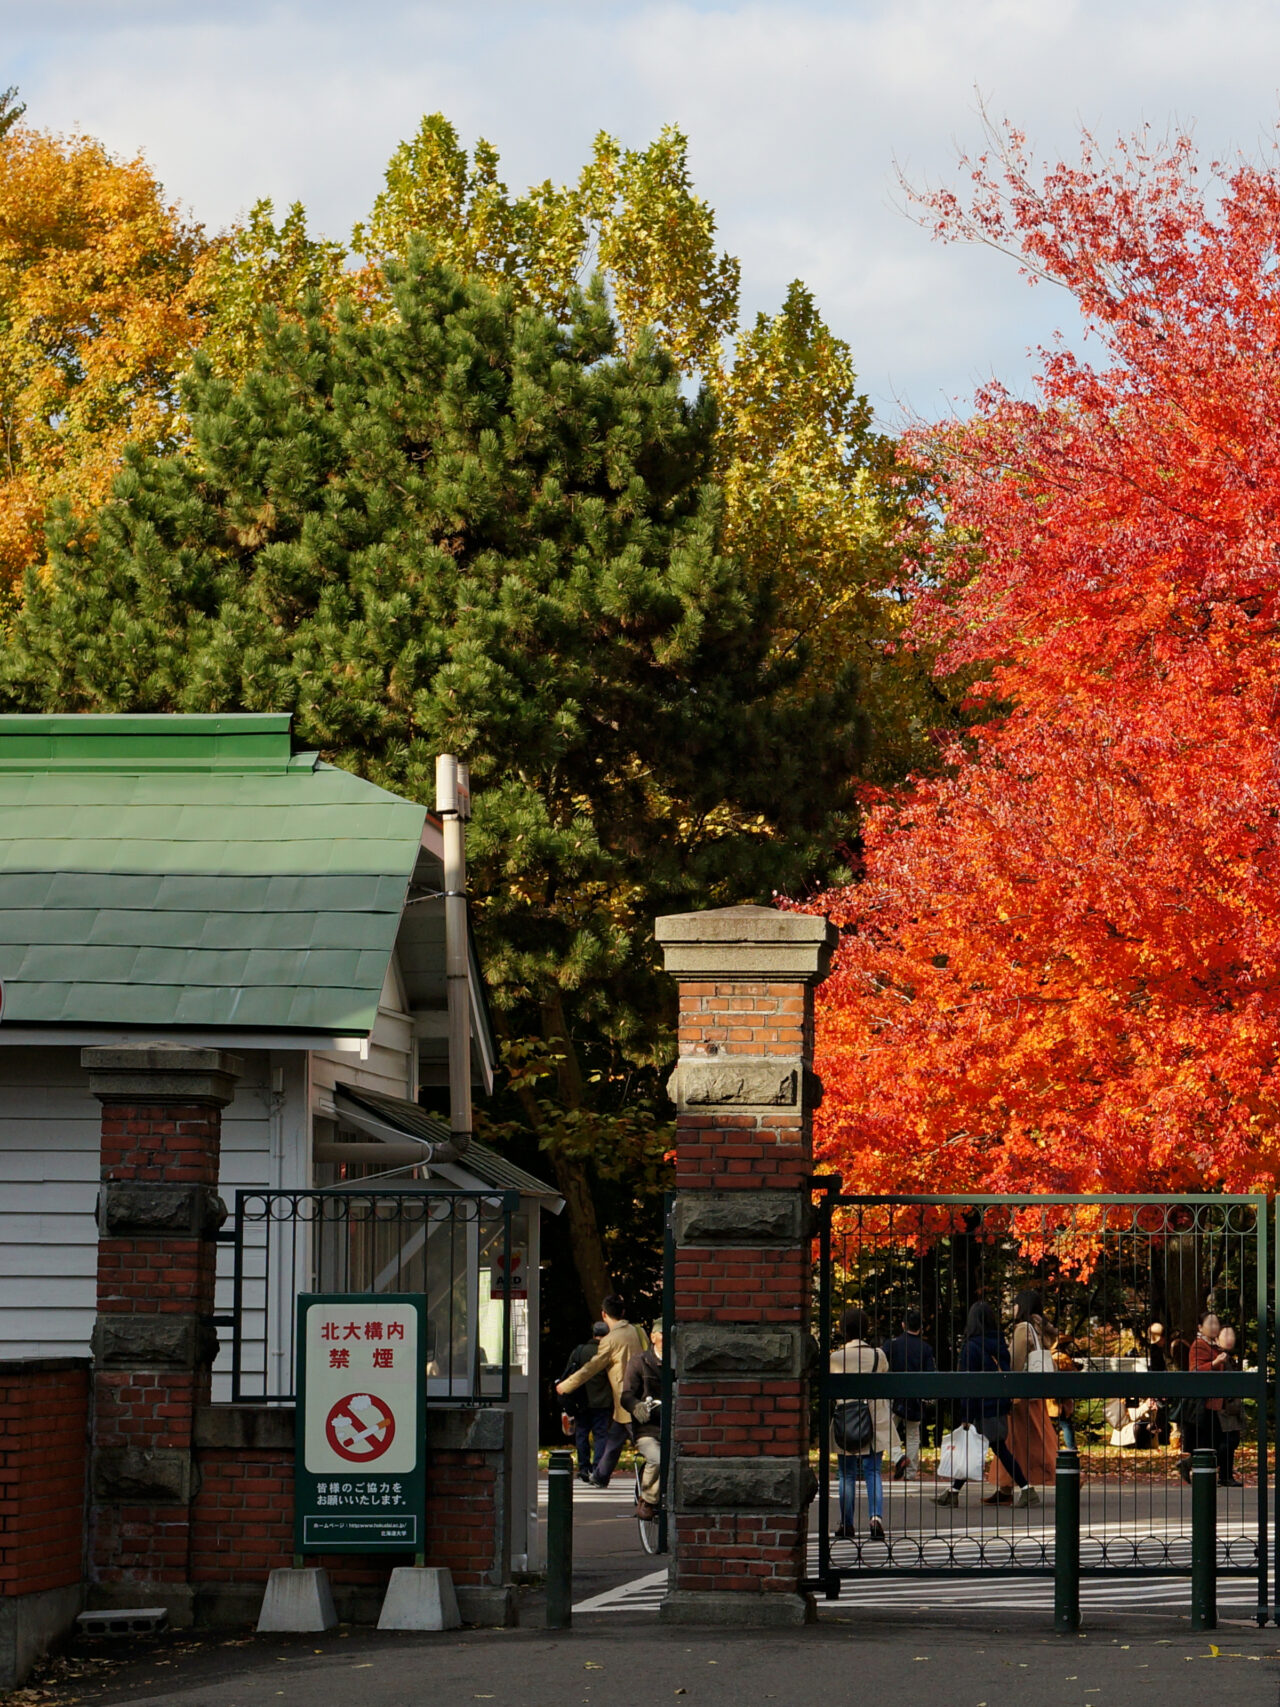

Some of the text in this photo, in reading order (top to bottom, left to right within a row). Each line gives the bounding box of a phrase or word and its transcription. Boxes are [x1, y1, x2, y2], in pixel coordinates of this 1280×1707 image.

[496, 1276, 522, 1284] AD
[321, 1321, 405, 1341] 北大構内
[316, 1481, 403, 1494] 皆様のご協力を
[316, 1494, 407, 1506] お願いいたします。
